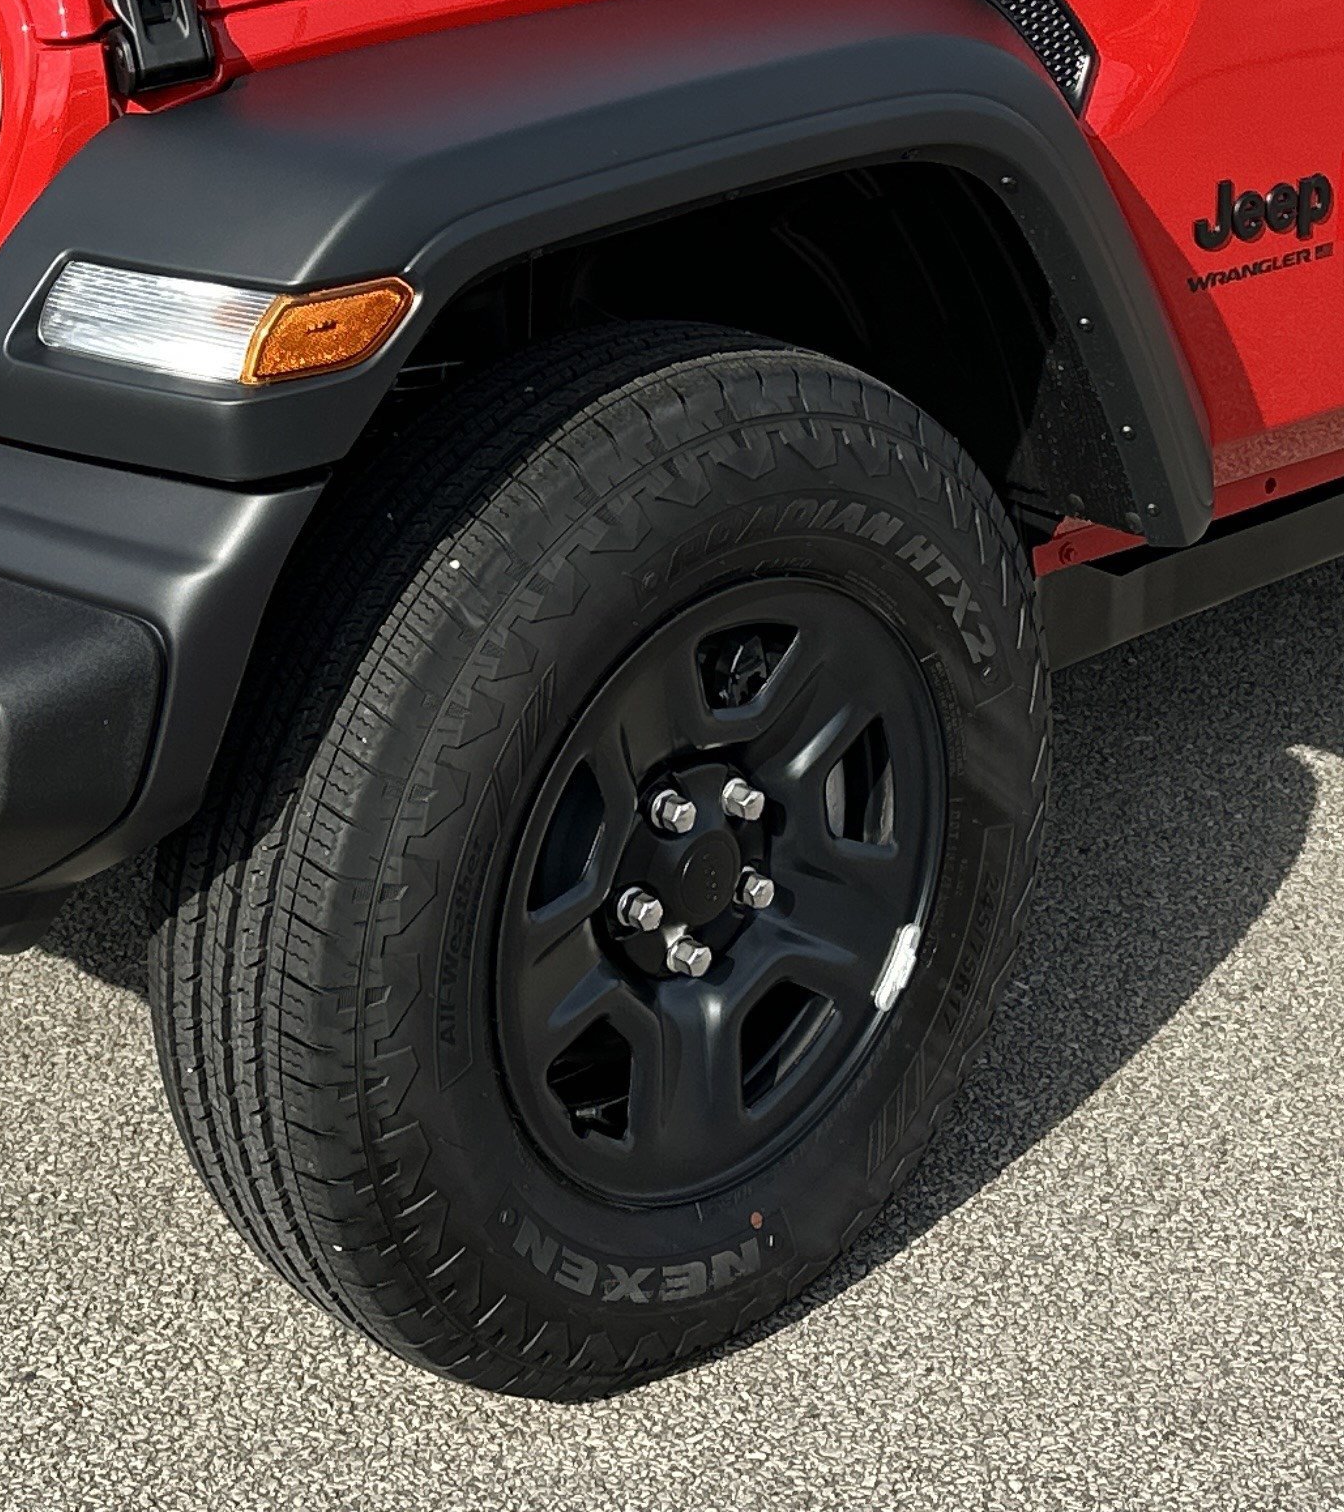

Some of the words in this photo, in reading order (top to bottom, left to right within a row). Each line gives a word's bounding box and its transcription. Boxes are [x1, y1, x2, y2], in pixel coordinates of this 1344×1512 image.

[1193, 172, 1334, 252] Jeep
[1187, 248, 1311, 293] WRANGLER
[894, 533, 998, 665] HTX2
[511, 1215, 763, 1305] NEXEN
